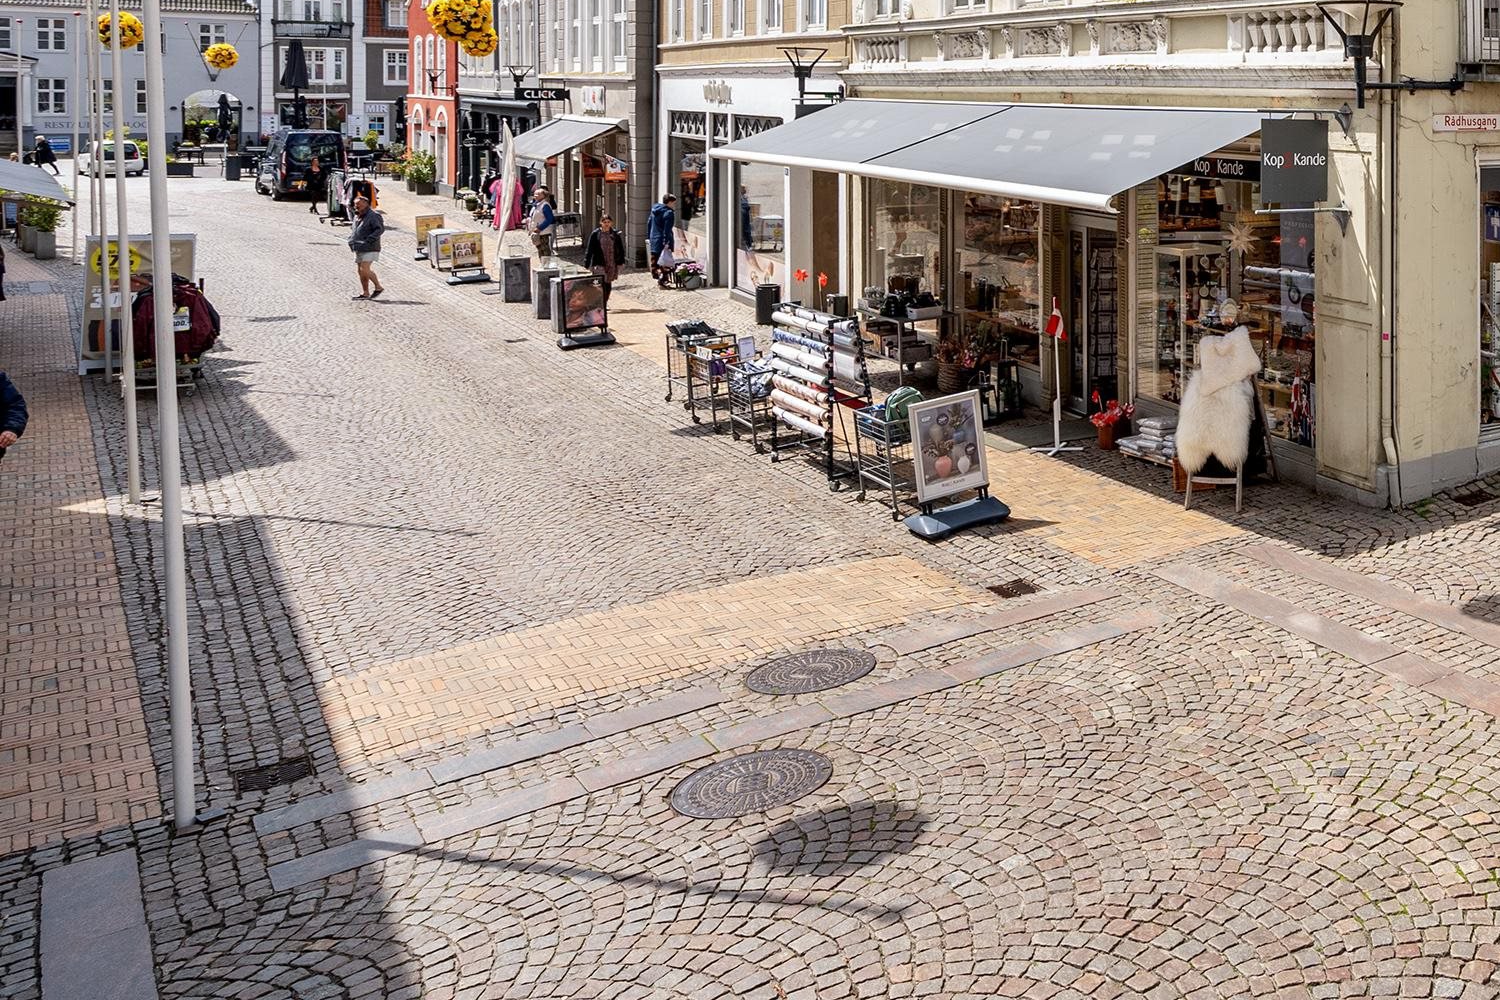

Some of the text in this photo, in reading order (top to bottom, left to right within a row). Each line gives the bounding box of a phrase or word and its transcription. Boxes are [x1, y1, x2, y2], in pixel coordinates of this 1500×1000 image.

[523, 89, 557, 99] CLICK
[365, 104, 388, 113] MIR
[1444, 115, 1498, 129] Rådhusgang
[1194, 158, 1210, 174] Kop
[1217, 159, 1244, 176] Kande
[1263, 152, 1285, 169] Kop
[1293, 152, 1326, 166] Kande
